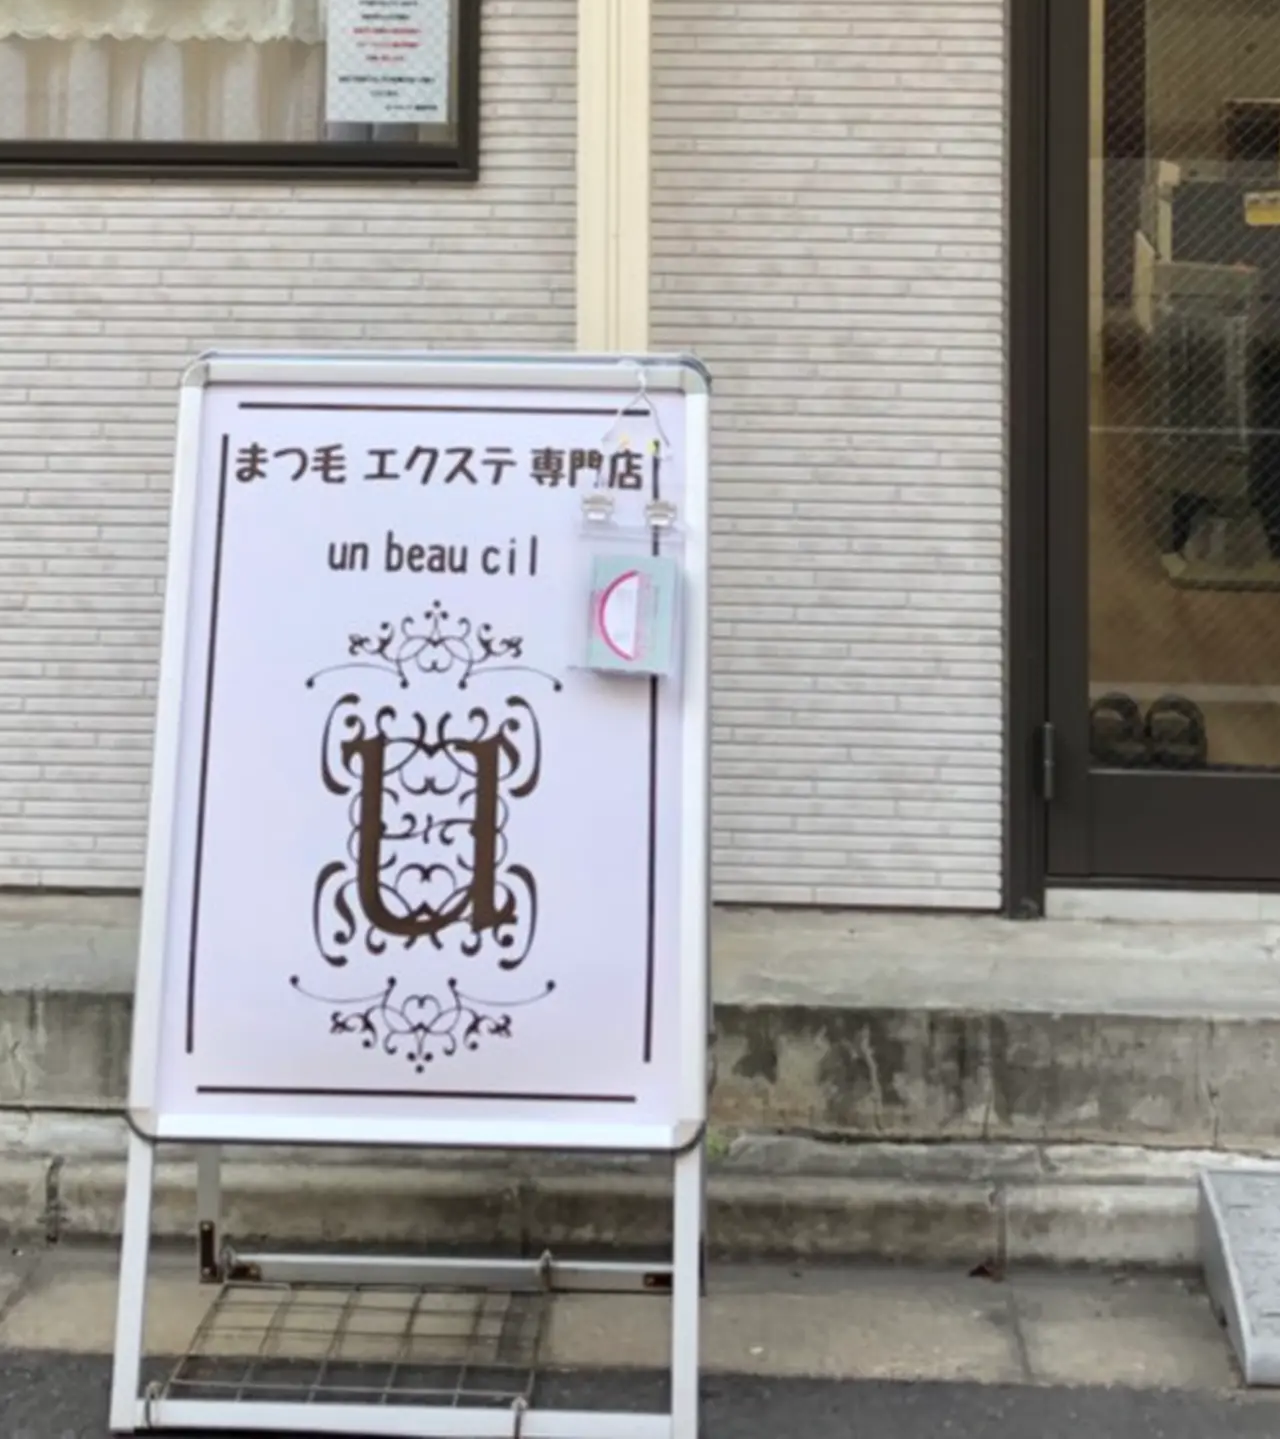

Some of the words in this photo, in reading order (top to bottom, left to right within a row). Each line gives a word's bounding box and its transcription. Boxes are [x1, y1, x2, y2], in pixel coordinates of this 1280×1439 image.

[327, 539, 369, 571] un
[385, 530, 468, 574] beau
[481, 535, 538, 577] cil
